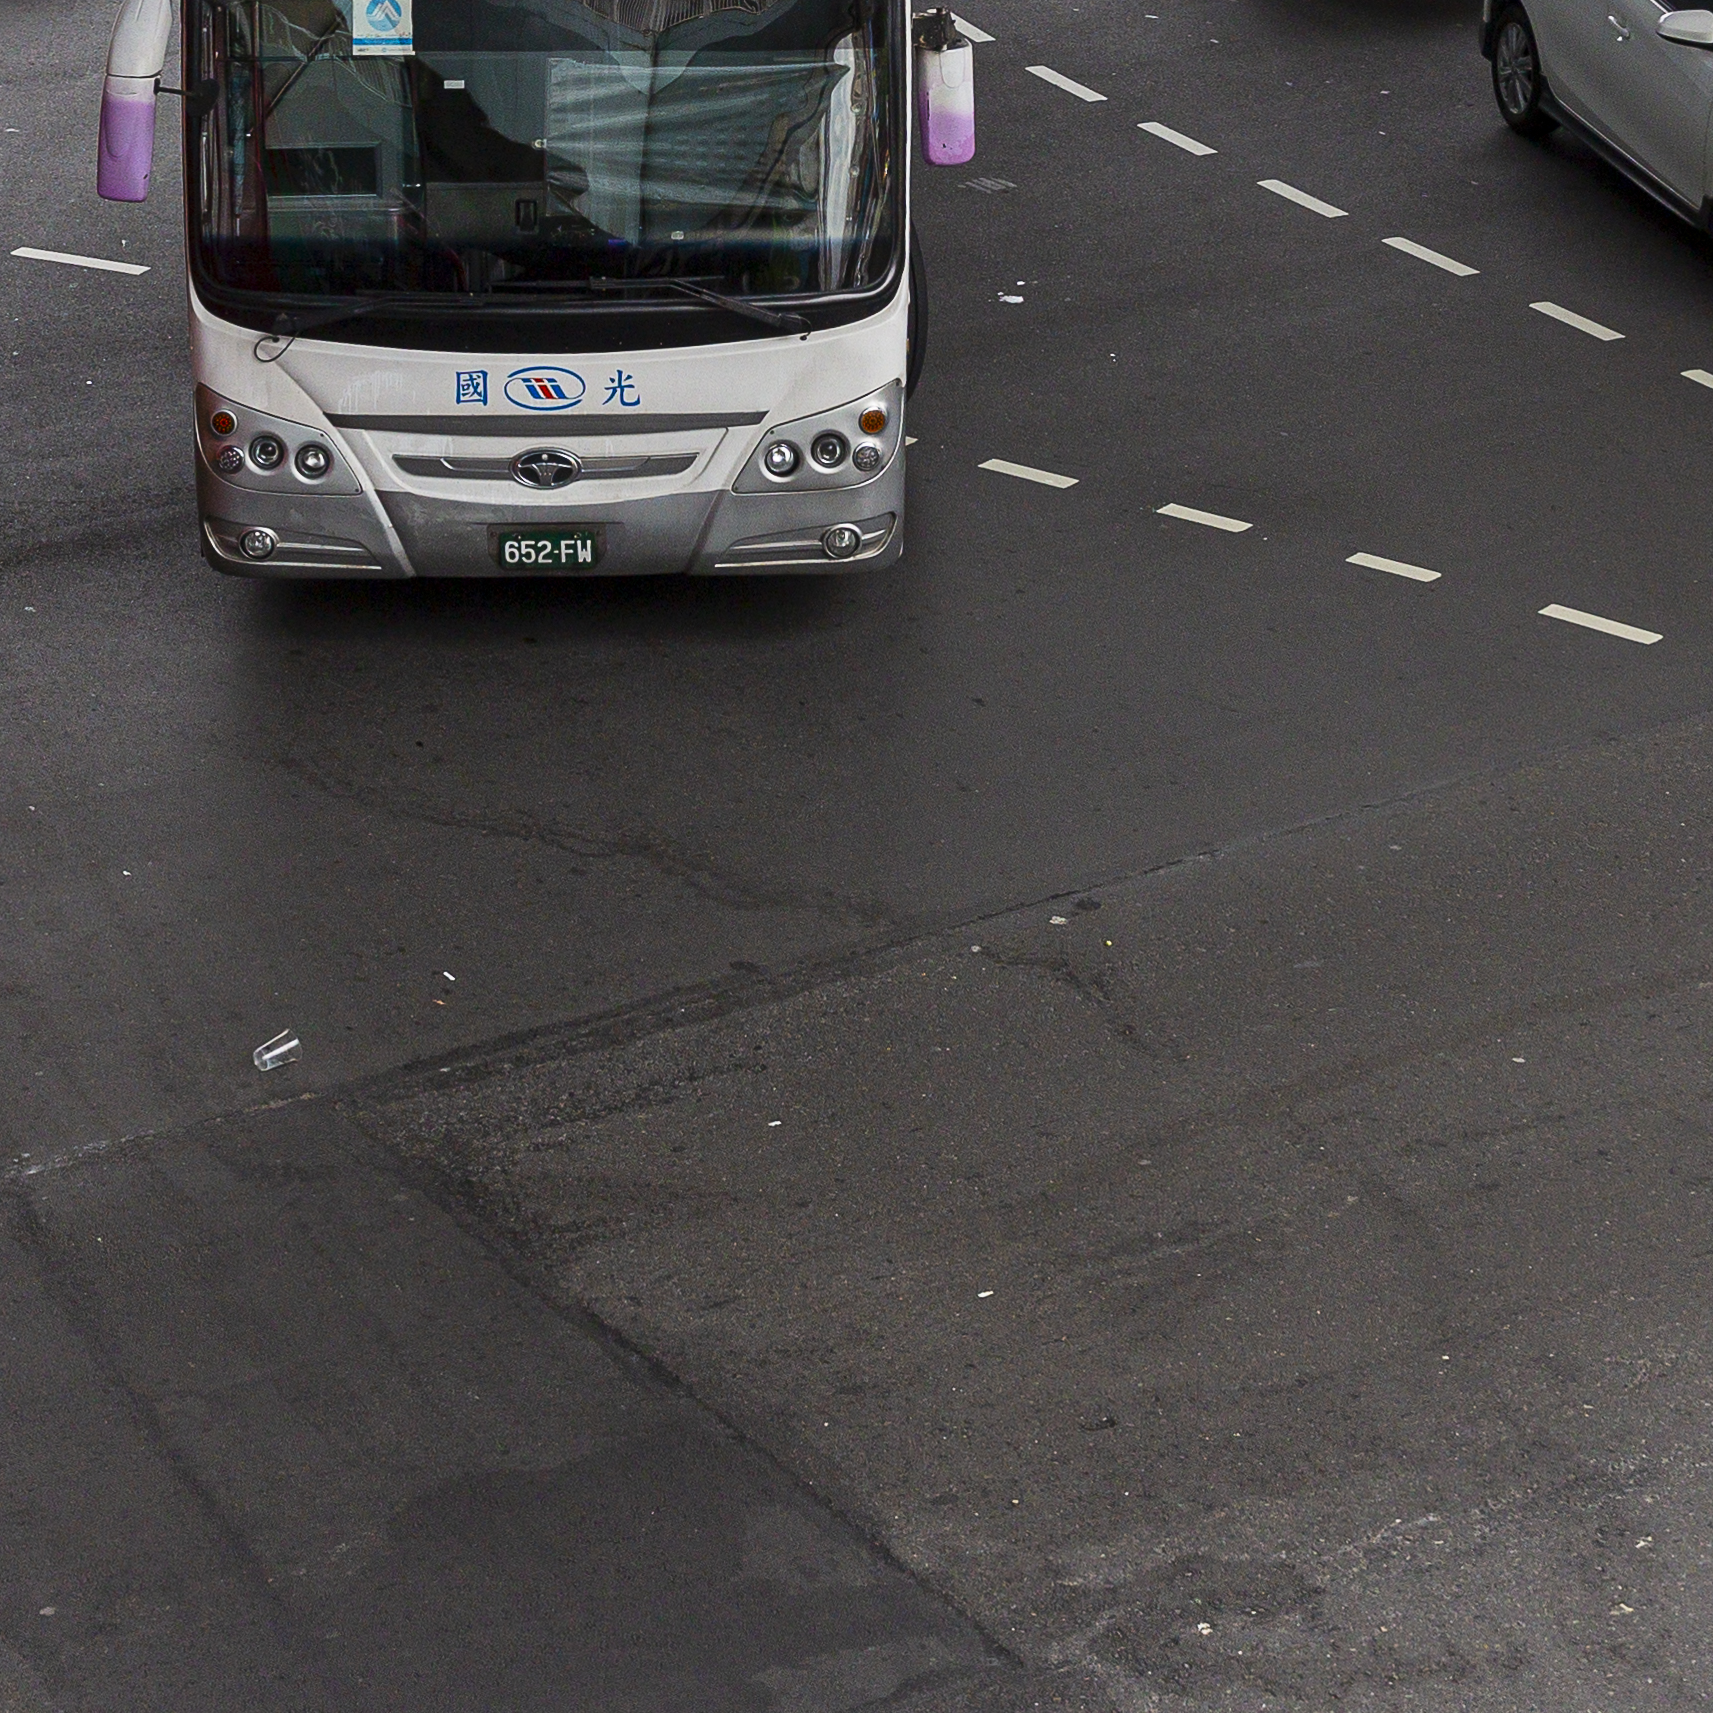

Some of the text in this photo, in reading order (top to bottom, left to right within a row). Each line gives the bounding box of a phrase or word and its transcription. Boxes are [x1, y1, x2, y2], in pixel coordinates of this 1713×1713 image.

[455, 369, 641, 406] 國 光
[504, 539, 592, 564] 652-FW
